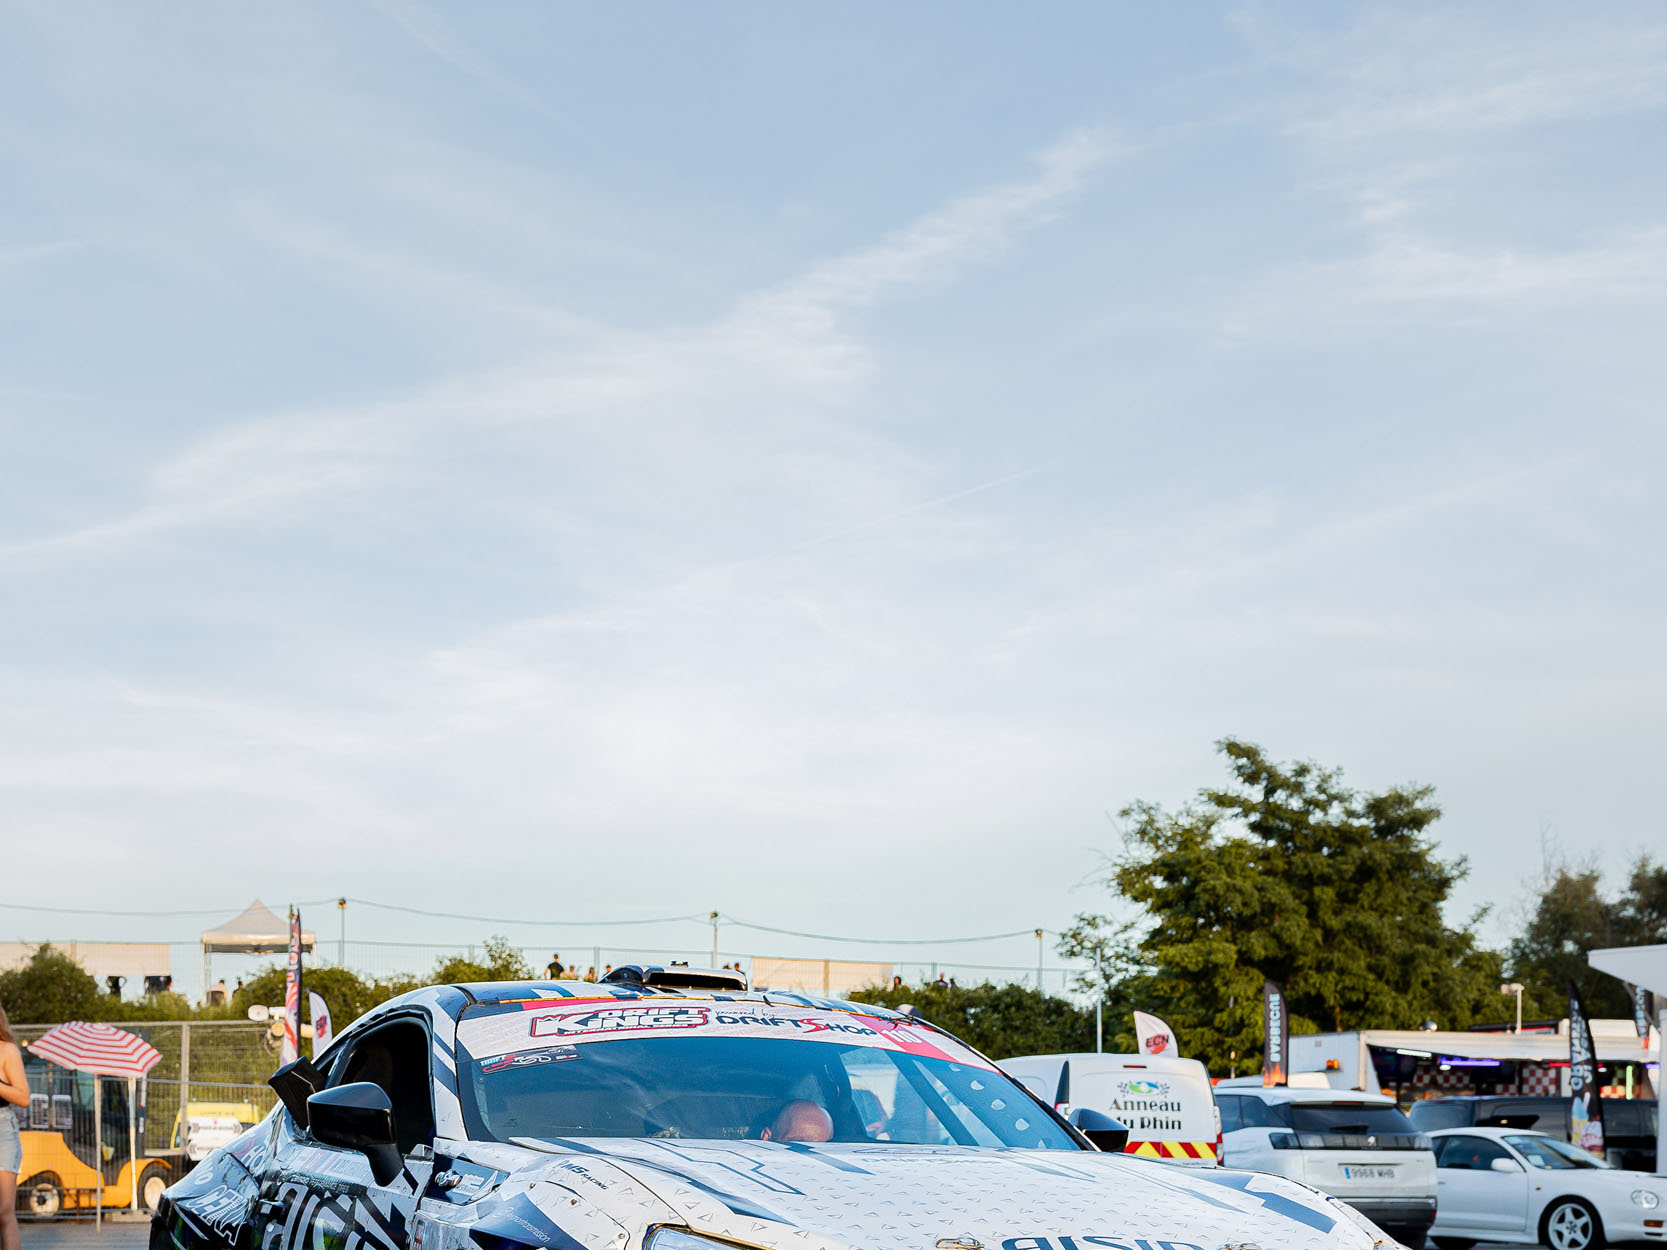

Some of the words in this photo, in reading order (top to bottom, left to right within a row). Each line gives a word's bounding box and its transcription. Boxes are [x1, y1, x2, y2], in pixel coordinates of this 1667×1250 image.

[598, 1008, 706, 1018] DRIFT
[881, 1029, 923, 1044] 110
[1146, 1035, 1169, 1048] ECN
[1109, 1098, 1181, 1112] Anneau
[1140, 1116, 1182, 1130] Rhin
